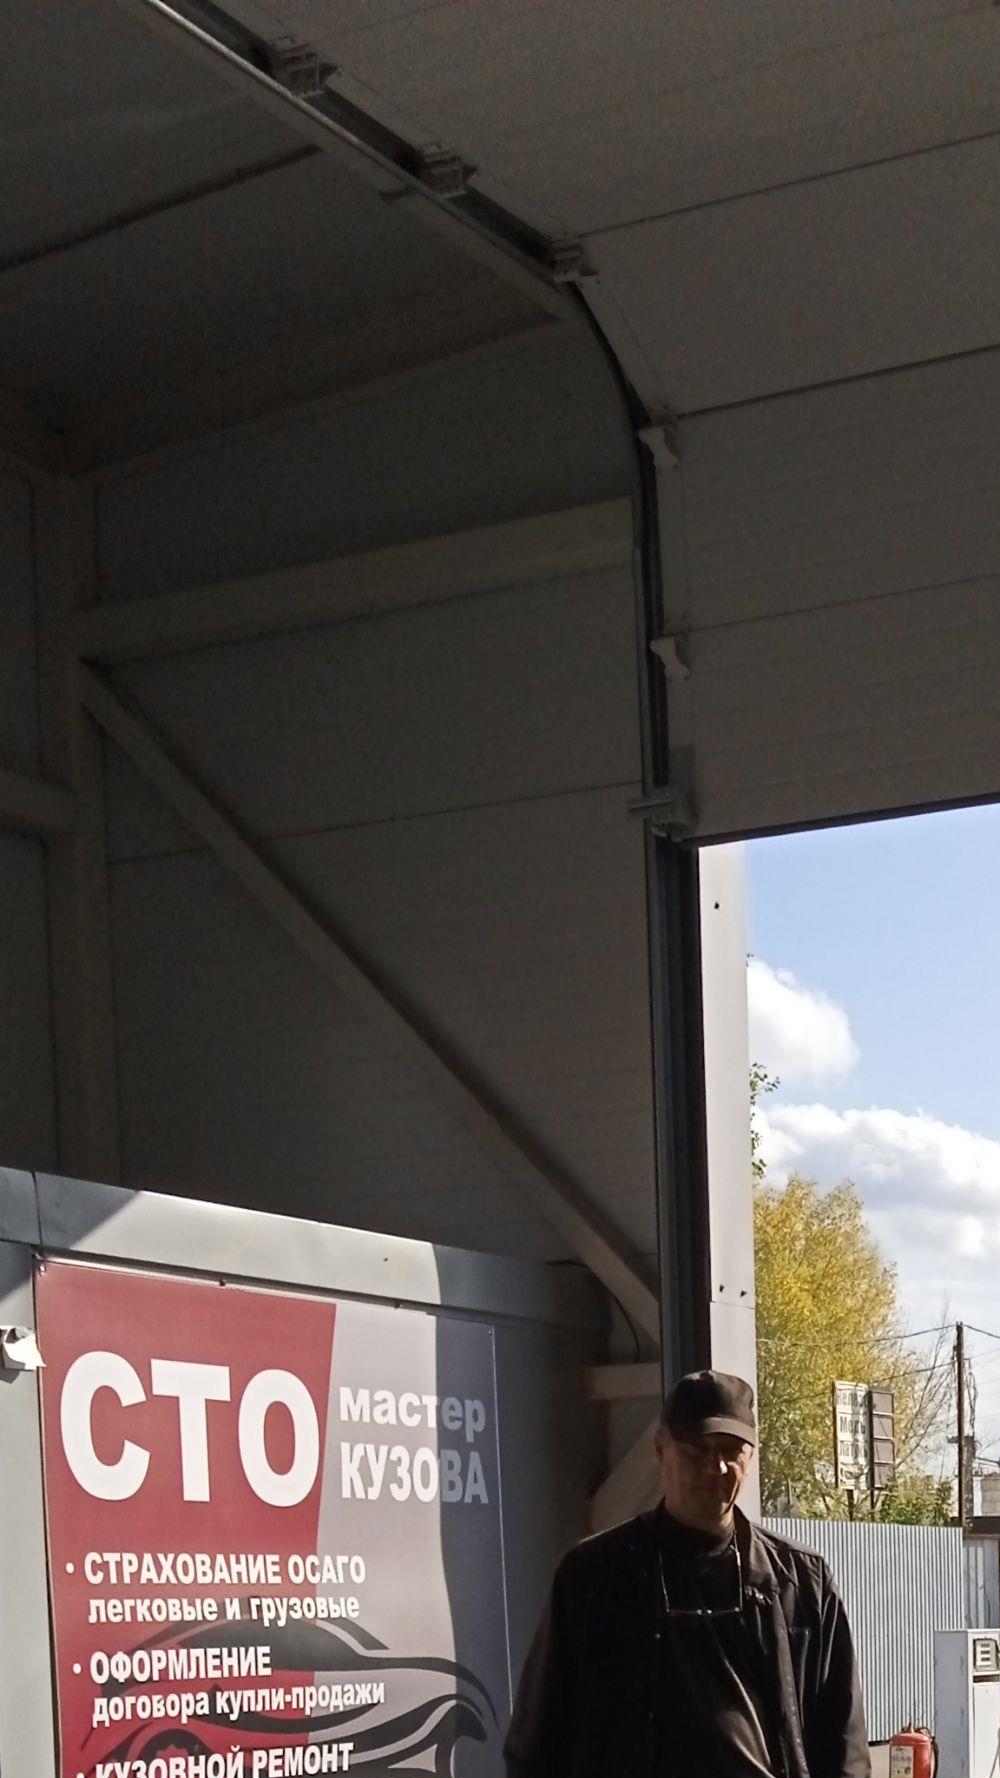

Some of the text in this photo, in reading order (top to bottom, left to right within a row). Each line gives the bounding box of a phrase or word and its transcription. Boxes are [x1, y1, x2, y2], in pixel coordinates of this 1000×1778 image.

[60, 1350, 320, 1508] СТО
[339, 1386, 486, 1442] мастер
[340, 1442, 489, 1504] КУЗОВА
[84, 1551, 366, 1585] СТРАХОВАНИЕ ОСАГО
[88, 1594, 360, 1627] легковые и грузовые
[89, 1646, 271, 1684] ОФОРМЛЕНИЕ
[92, 1682, 385, 1727] договора купли-продажи
